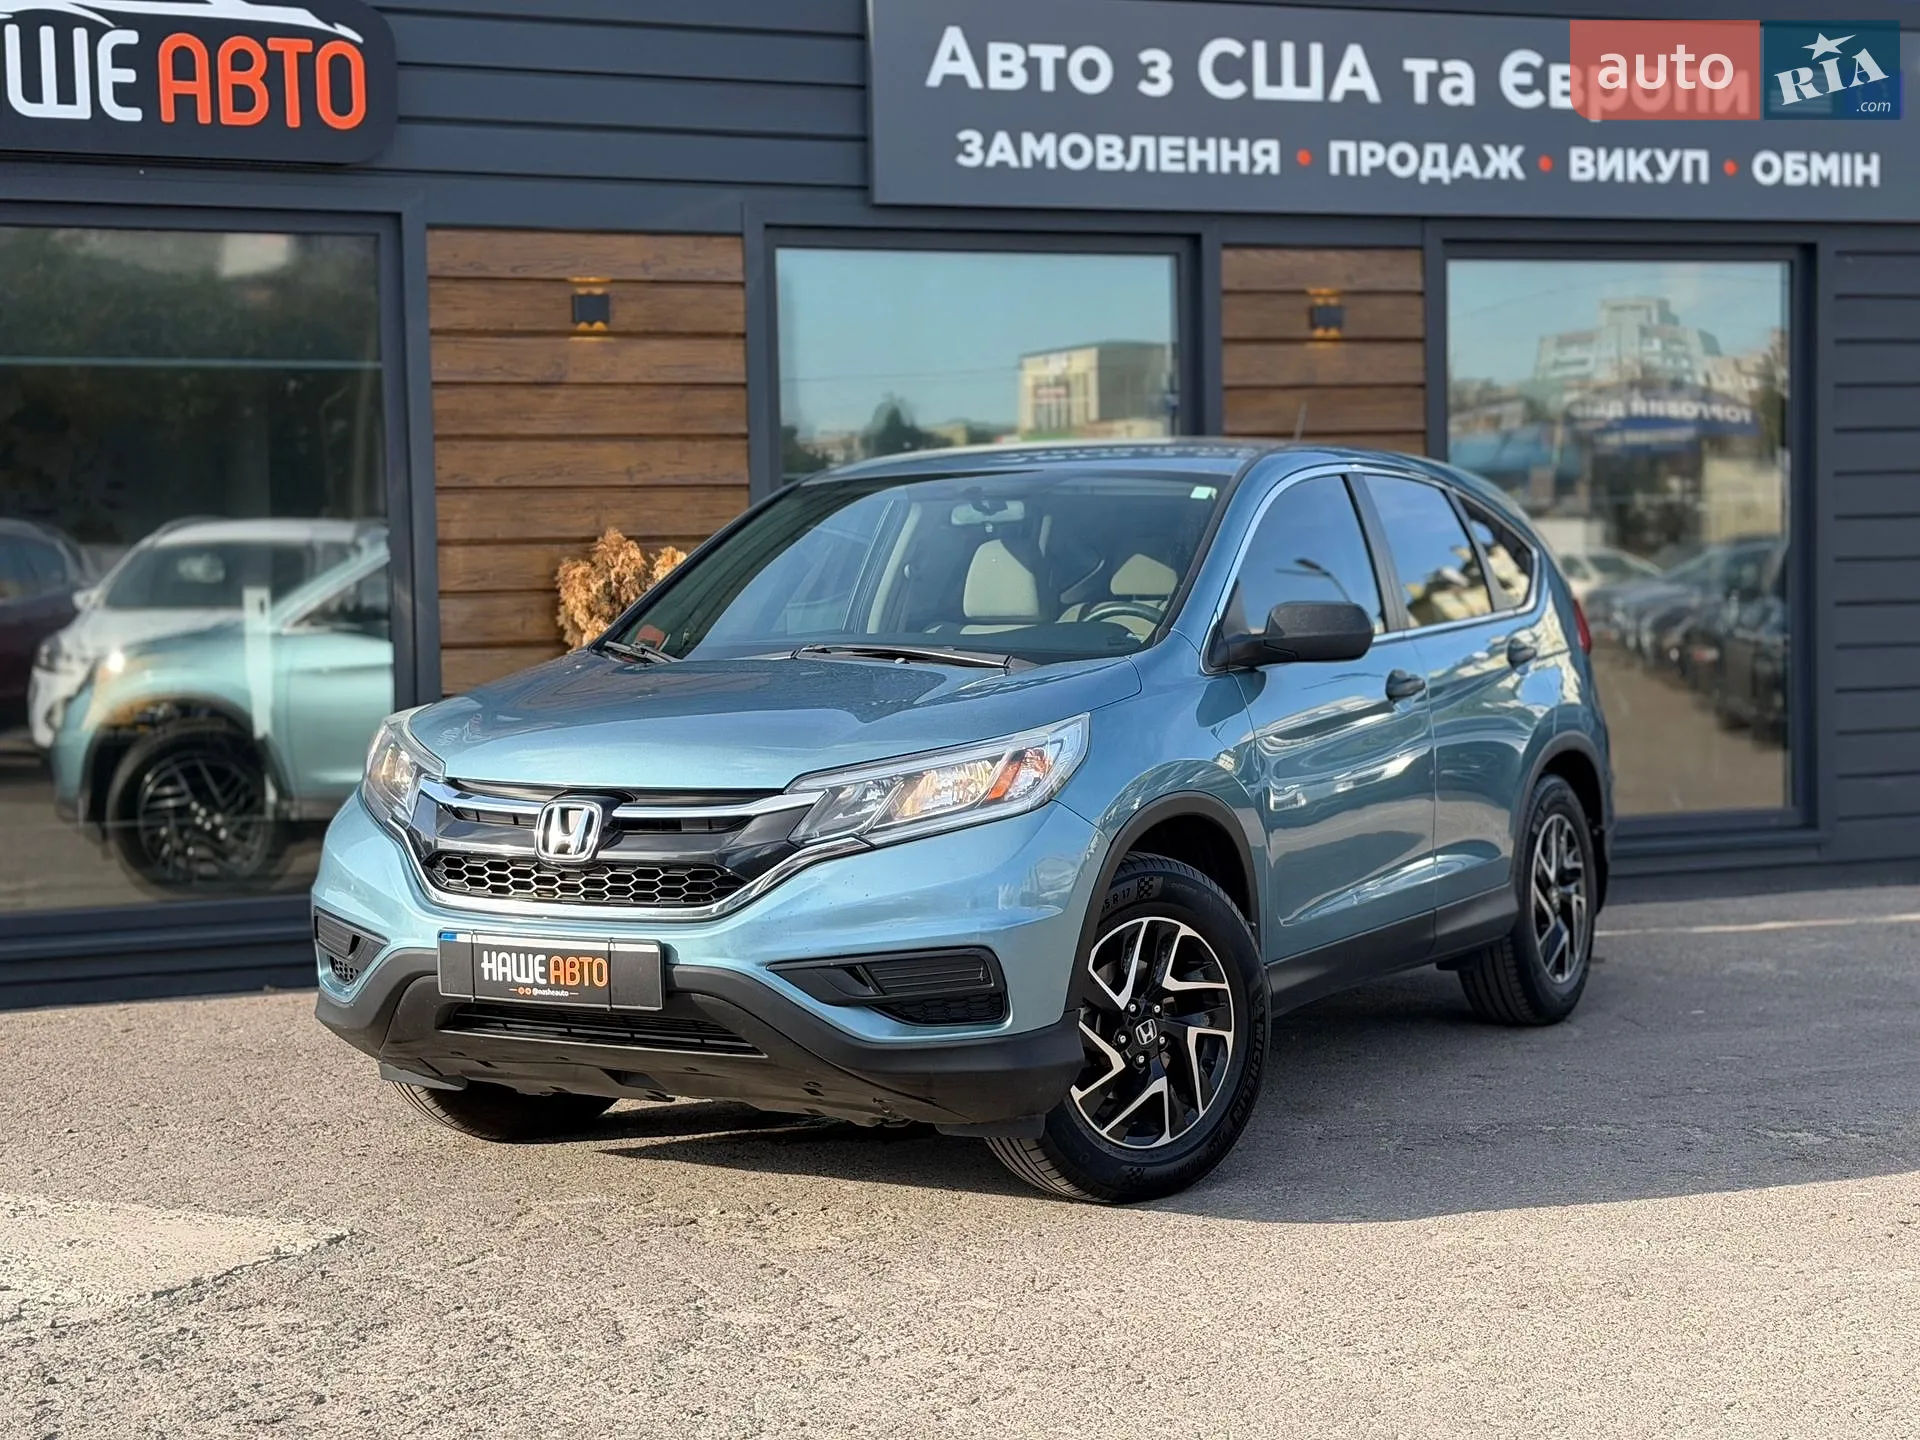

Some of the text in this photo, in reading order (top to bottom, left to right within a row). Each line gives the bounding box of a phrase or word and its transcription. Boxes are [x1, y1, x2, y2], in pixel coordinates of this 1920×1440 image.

[158, 32, 366, 130] АВТО
[925, 26, 1114, 95] Авто
[1137, 48, 1173, 98] з
[1198, 37, 1382, 103] США
[1403, 57, 1476, 107] та
[955, 129, 1881, 187] ЗАМОВЛЕННЯ ПРОДАЖ ВИКУП ОБМІН
[481, 950, 608, 987] НАШЕ АВТО
[1231, 1022, 1265, 1120] MICHELIN
